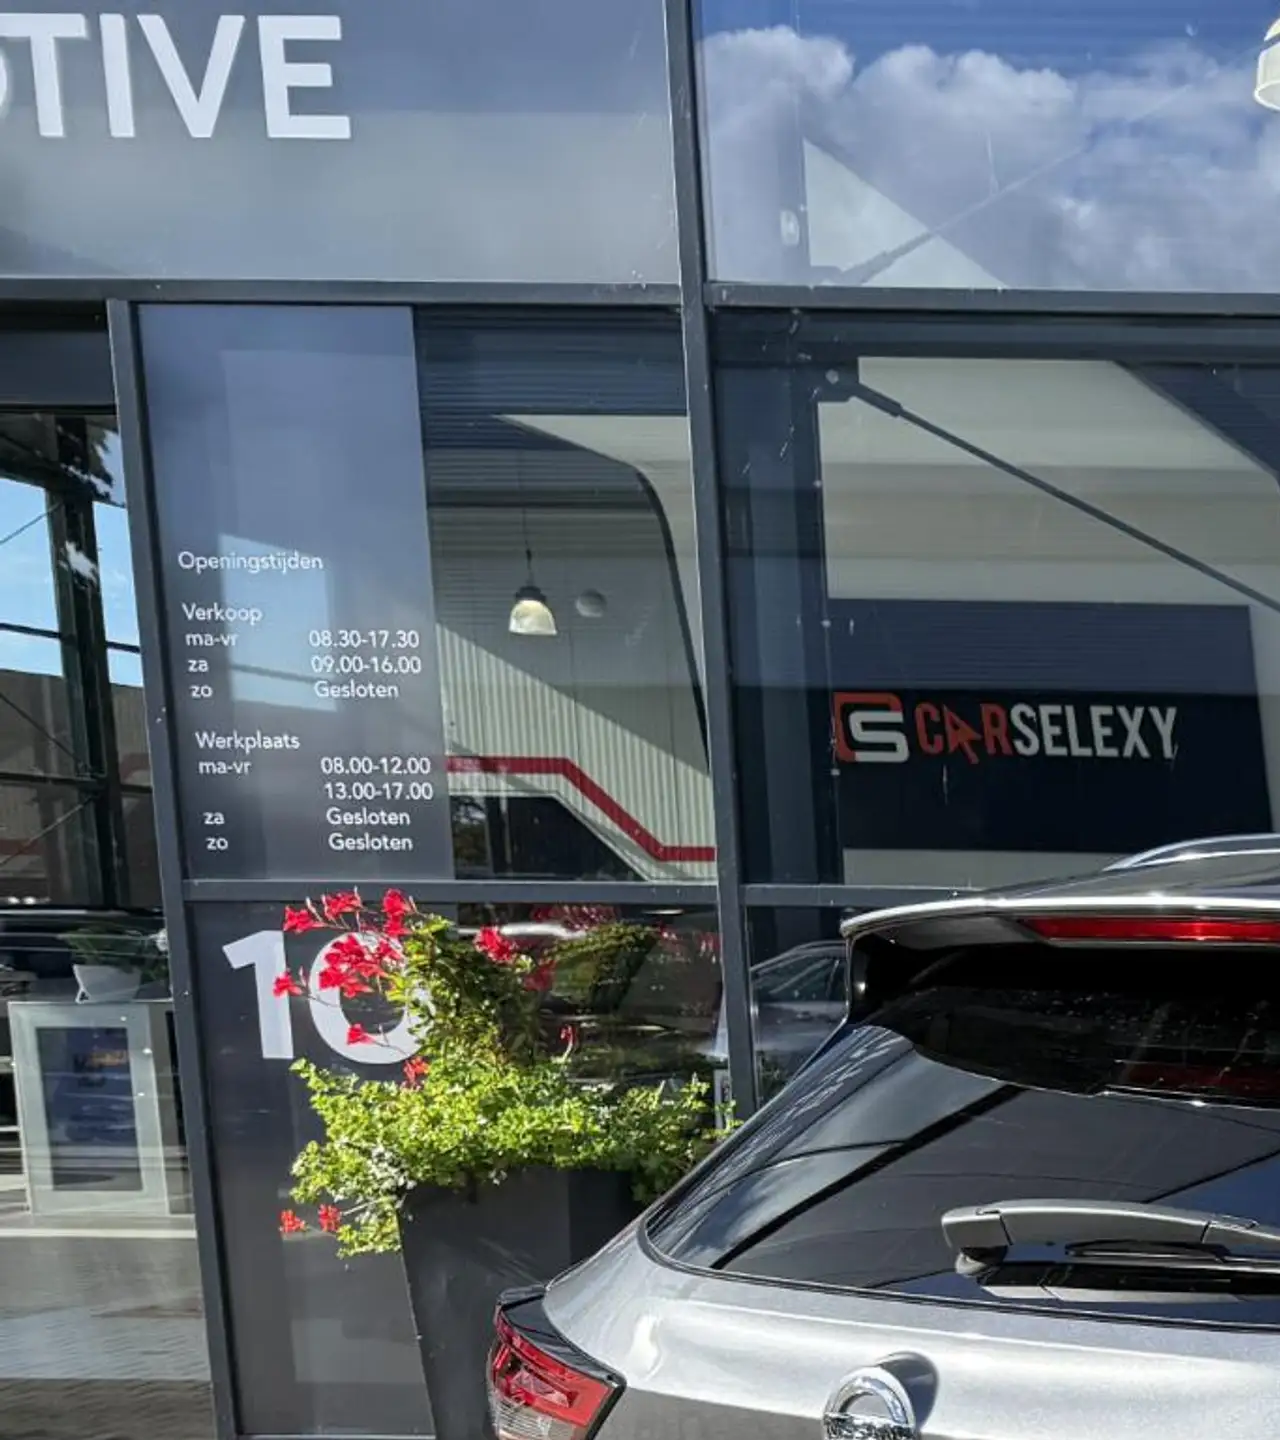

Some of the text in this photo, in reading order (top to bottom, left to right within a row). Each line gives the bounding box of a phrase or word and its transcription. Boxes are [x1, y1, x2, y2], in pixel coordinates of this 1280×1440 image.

[0, 13, 351, 139] TIVE
[177, 551, 323, 574] Openingstijden
[182, 602, 263, 625] Verkoop
[185, 630, 420, 649] ma-vr 08.30-17.30
[187, 655, 422, 674] za 09.00-16.00
[190, 680, 400, 699] zo Gesloten
[195, 731, 300, 754] Werkplaats
[914, 702, 1178, 765] CARSELEXY
[198, 757, 432, 775] ma-vr 08.00-12.00
[324, 782, 434, 800] 13.00-17.00
[203, 807, 411, 826] za Gesloten
[206, 833, 414, 851] zo Gesloten
